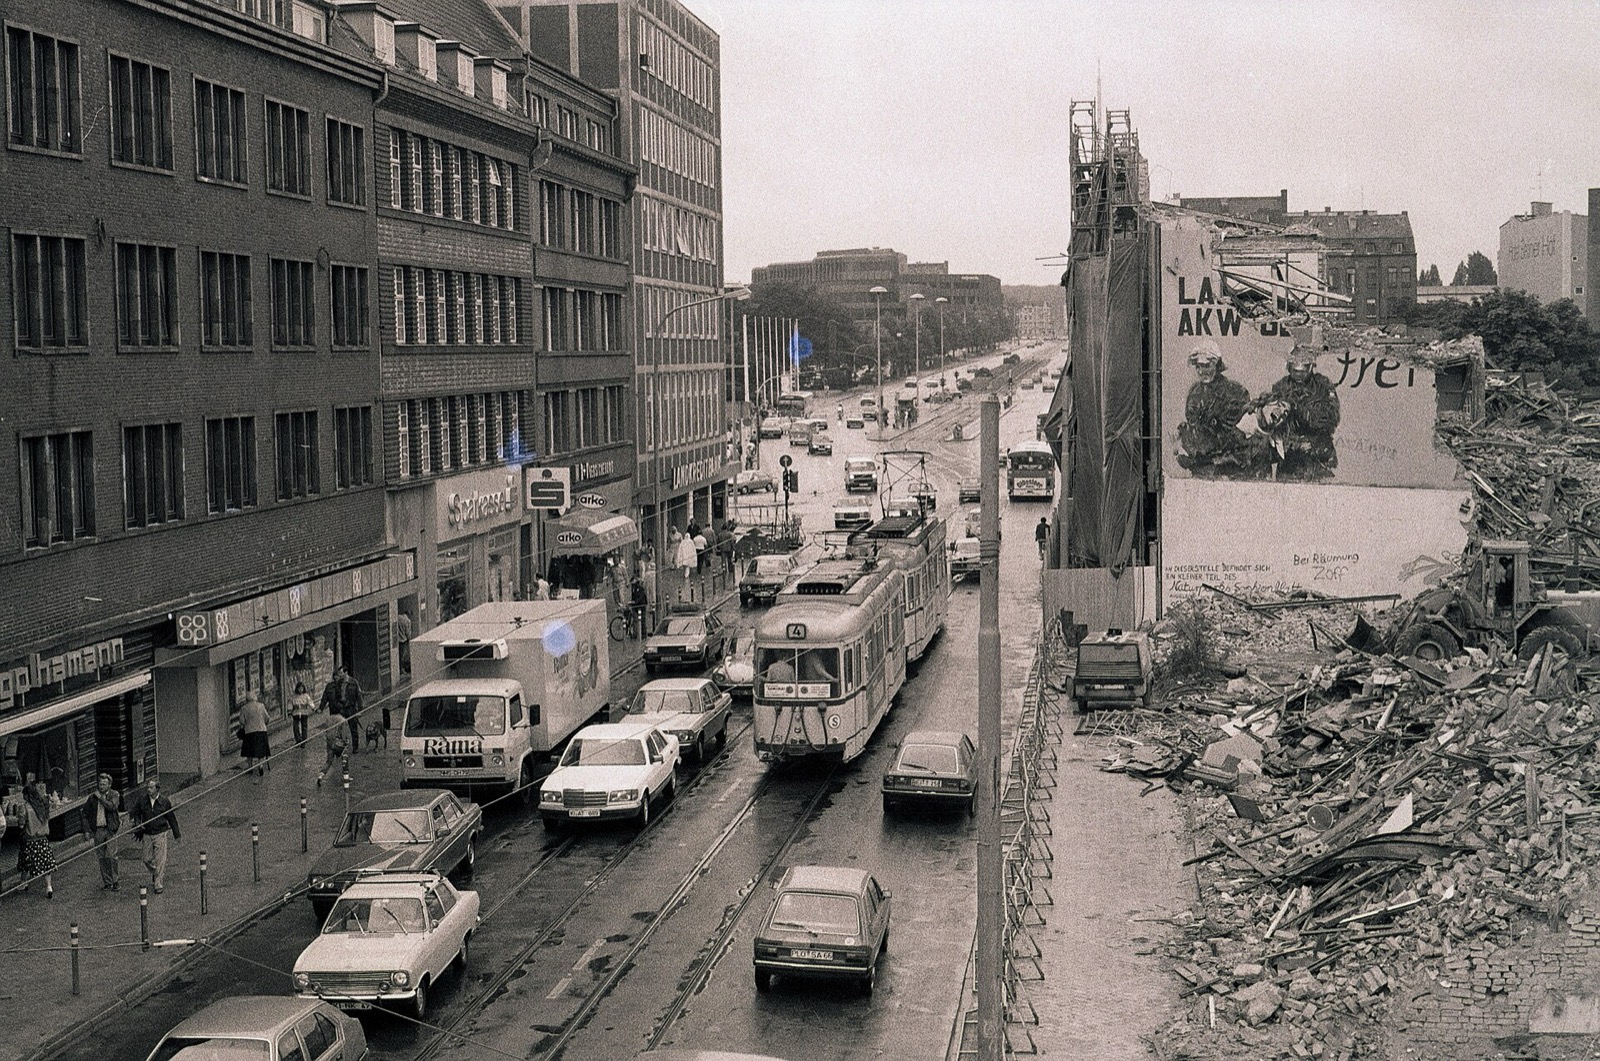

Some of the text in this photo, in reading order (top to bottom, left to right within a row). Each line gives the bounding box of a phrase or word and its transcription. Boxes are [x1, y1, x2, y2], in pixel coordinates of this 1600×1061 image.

[580, 495, 605, 506] arko
[558, 532, 581, 543] arko
[1312, 553, 1360, 566] Räumung
[1312, 566, 1349, 582] Zoff
[793, 625, 801, 636] 4
[832, 716, 839, 727] S
[424, 739, 483, 756] Rama
